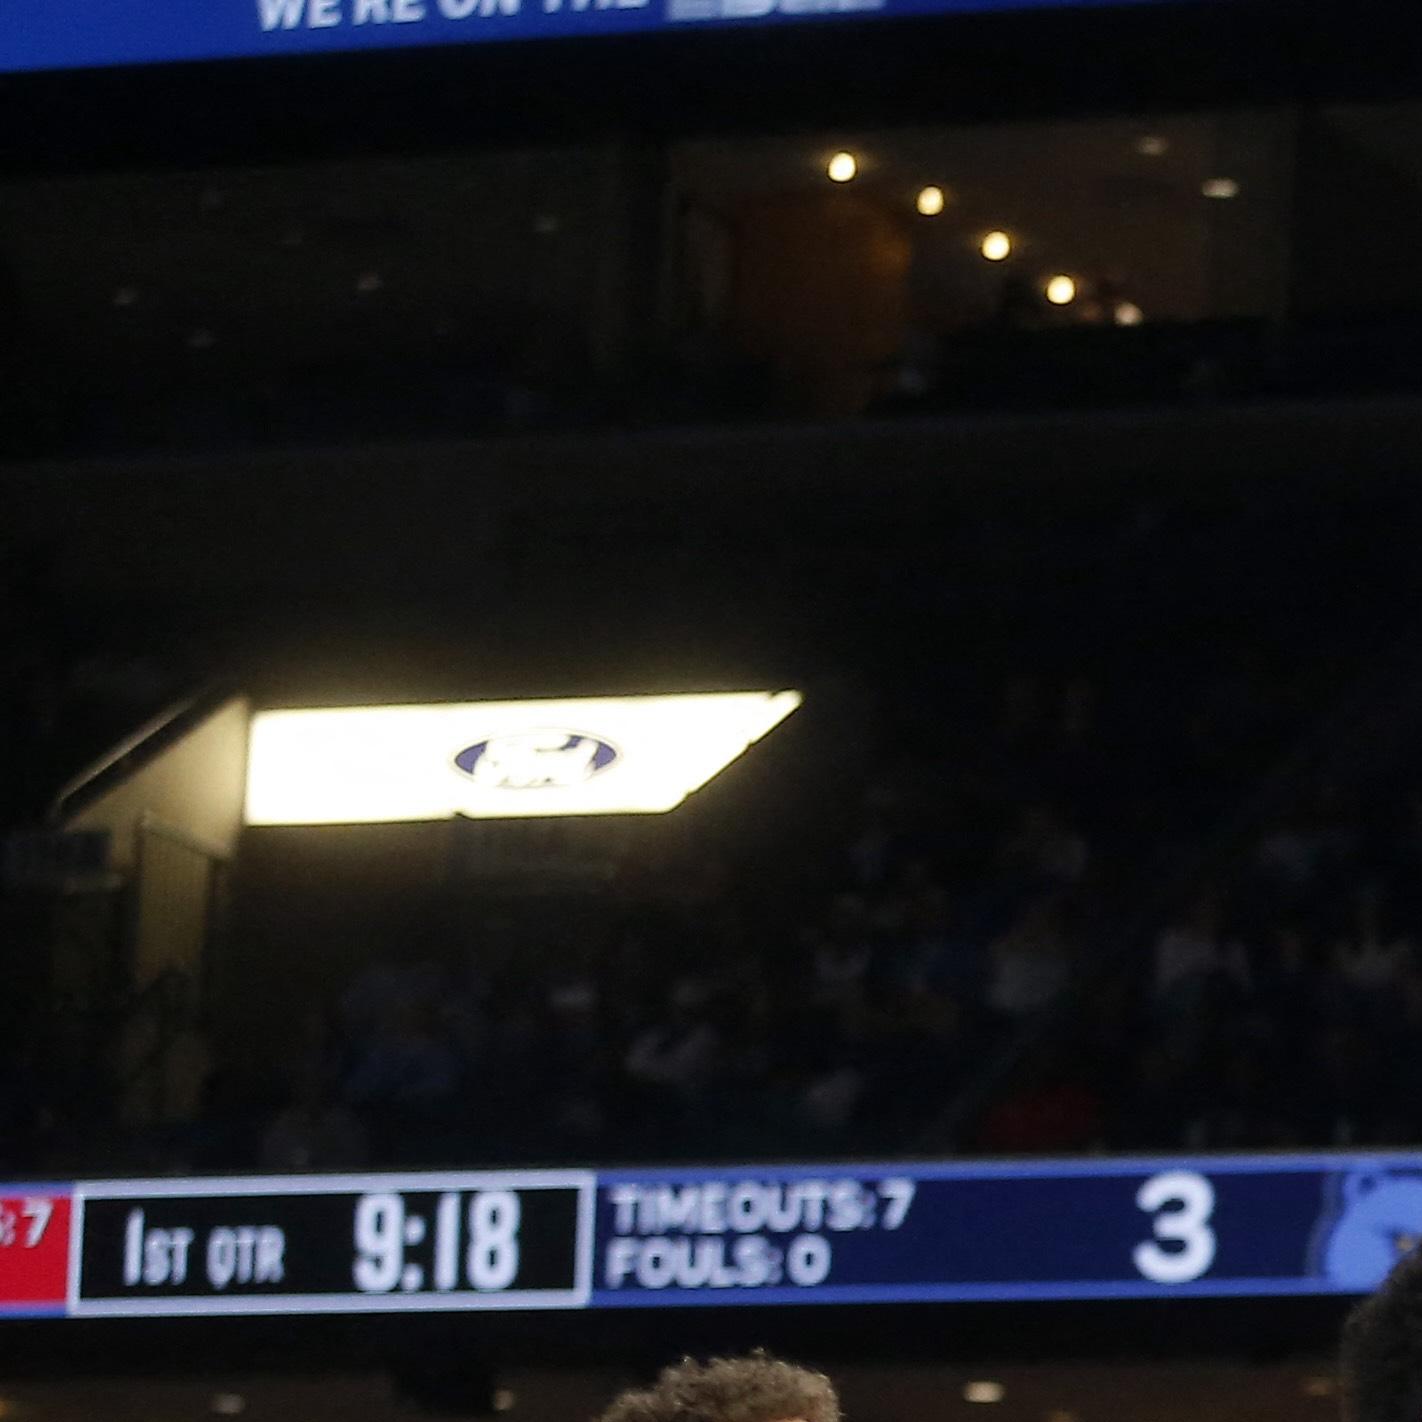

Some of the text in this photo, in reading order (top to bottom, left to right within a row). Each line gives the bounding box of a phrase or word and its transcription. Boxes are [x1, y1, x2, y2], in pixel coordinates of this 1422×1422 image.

[207, 1226, 286, 1290] QTR
[354, 1190, 521, 1294] 9:18
[1133, 1171, 1217, 1284] 3
